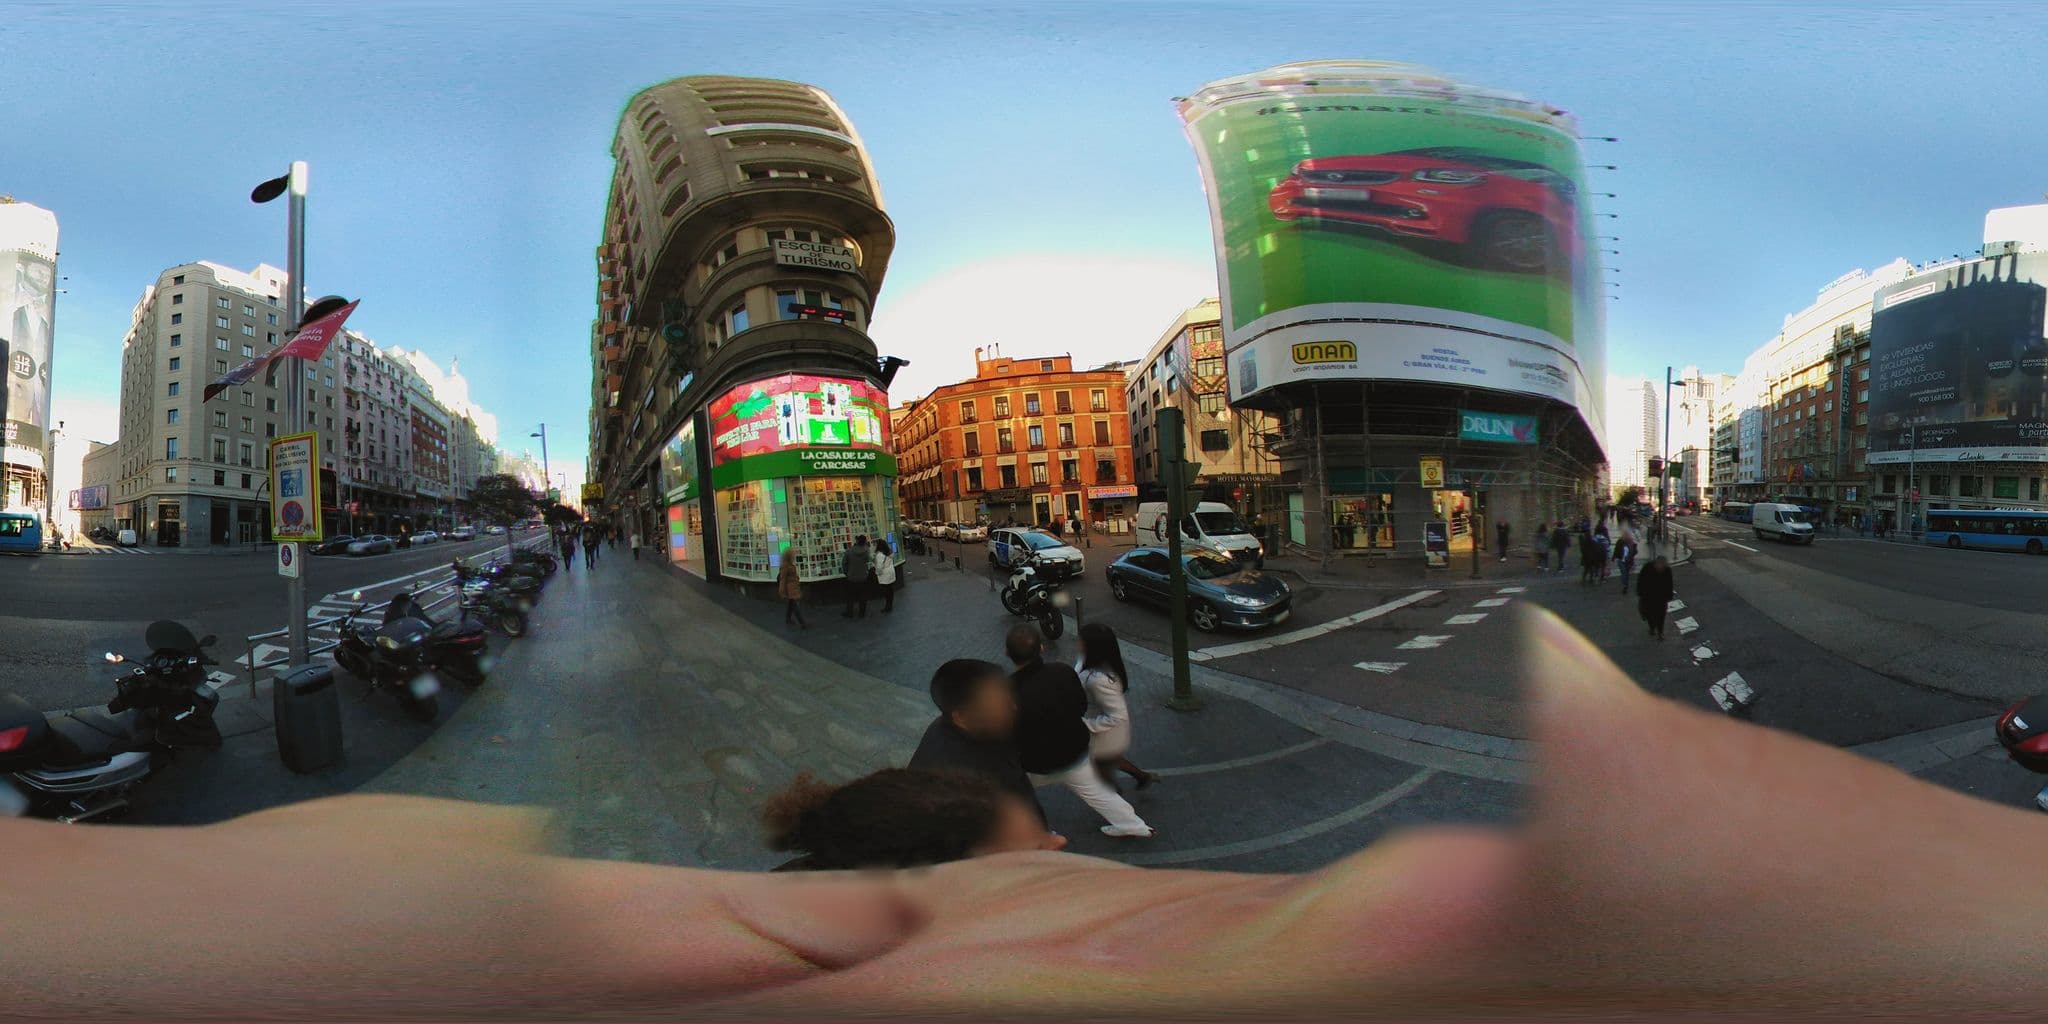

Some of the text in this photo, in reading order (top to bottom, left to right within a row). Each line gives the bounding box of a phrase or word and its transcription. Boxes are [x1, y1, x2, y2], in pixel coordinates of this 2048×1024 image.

[779, 241, 852, 258] ESCUELA
[781, 254, 852, 271] TURISMO
[1296, 344, 1353, 360] UNAN
[1891, 341, 1934, 359] VIVIENDAS
[1880, 354, 1925, 371] EXCLUSIVAS
[1890, 364, 1926, 378] ALCANCE
[1914, 371, 1946, 384] LOCOS
[1462, 416, 1514, 436] DRUNI
[818, 451, 842, 460] CASA
[857, 452, 876, 460] LAS
[813, 461, 866, 470] CARCASAS
